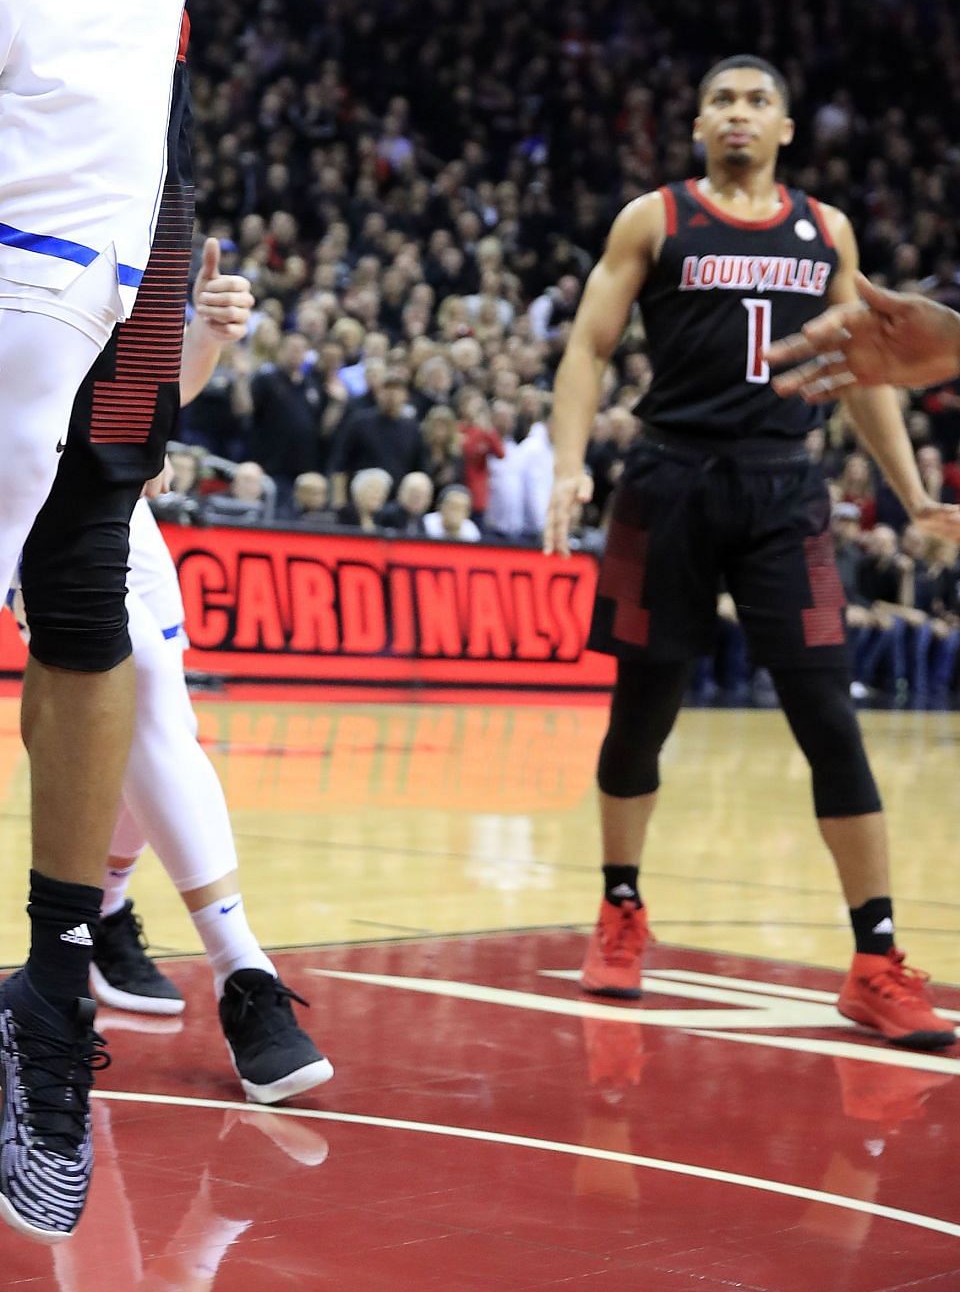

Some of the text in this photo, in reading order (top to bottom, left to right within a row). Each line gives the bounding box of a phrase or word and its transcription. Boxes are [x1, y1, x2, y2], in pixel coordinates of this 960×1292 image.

[679, 255, 831, 296] LOUISVILLE
[741, 298, 772, 384] 1
[176, 549, 583, 663] CARDINALS
